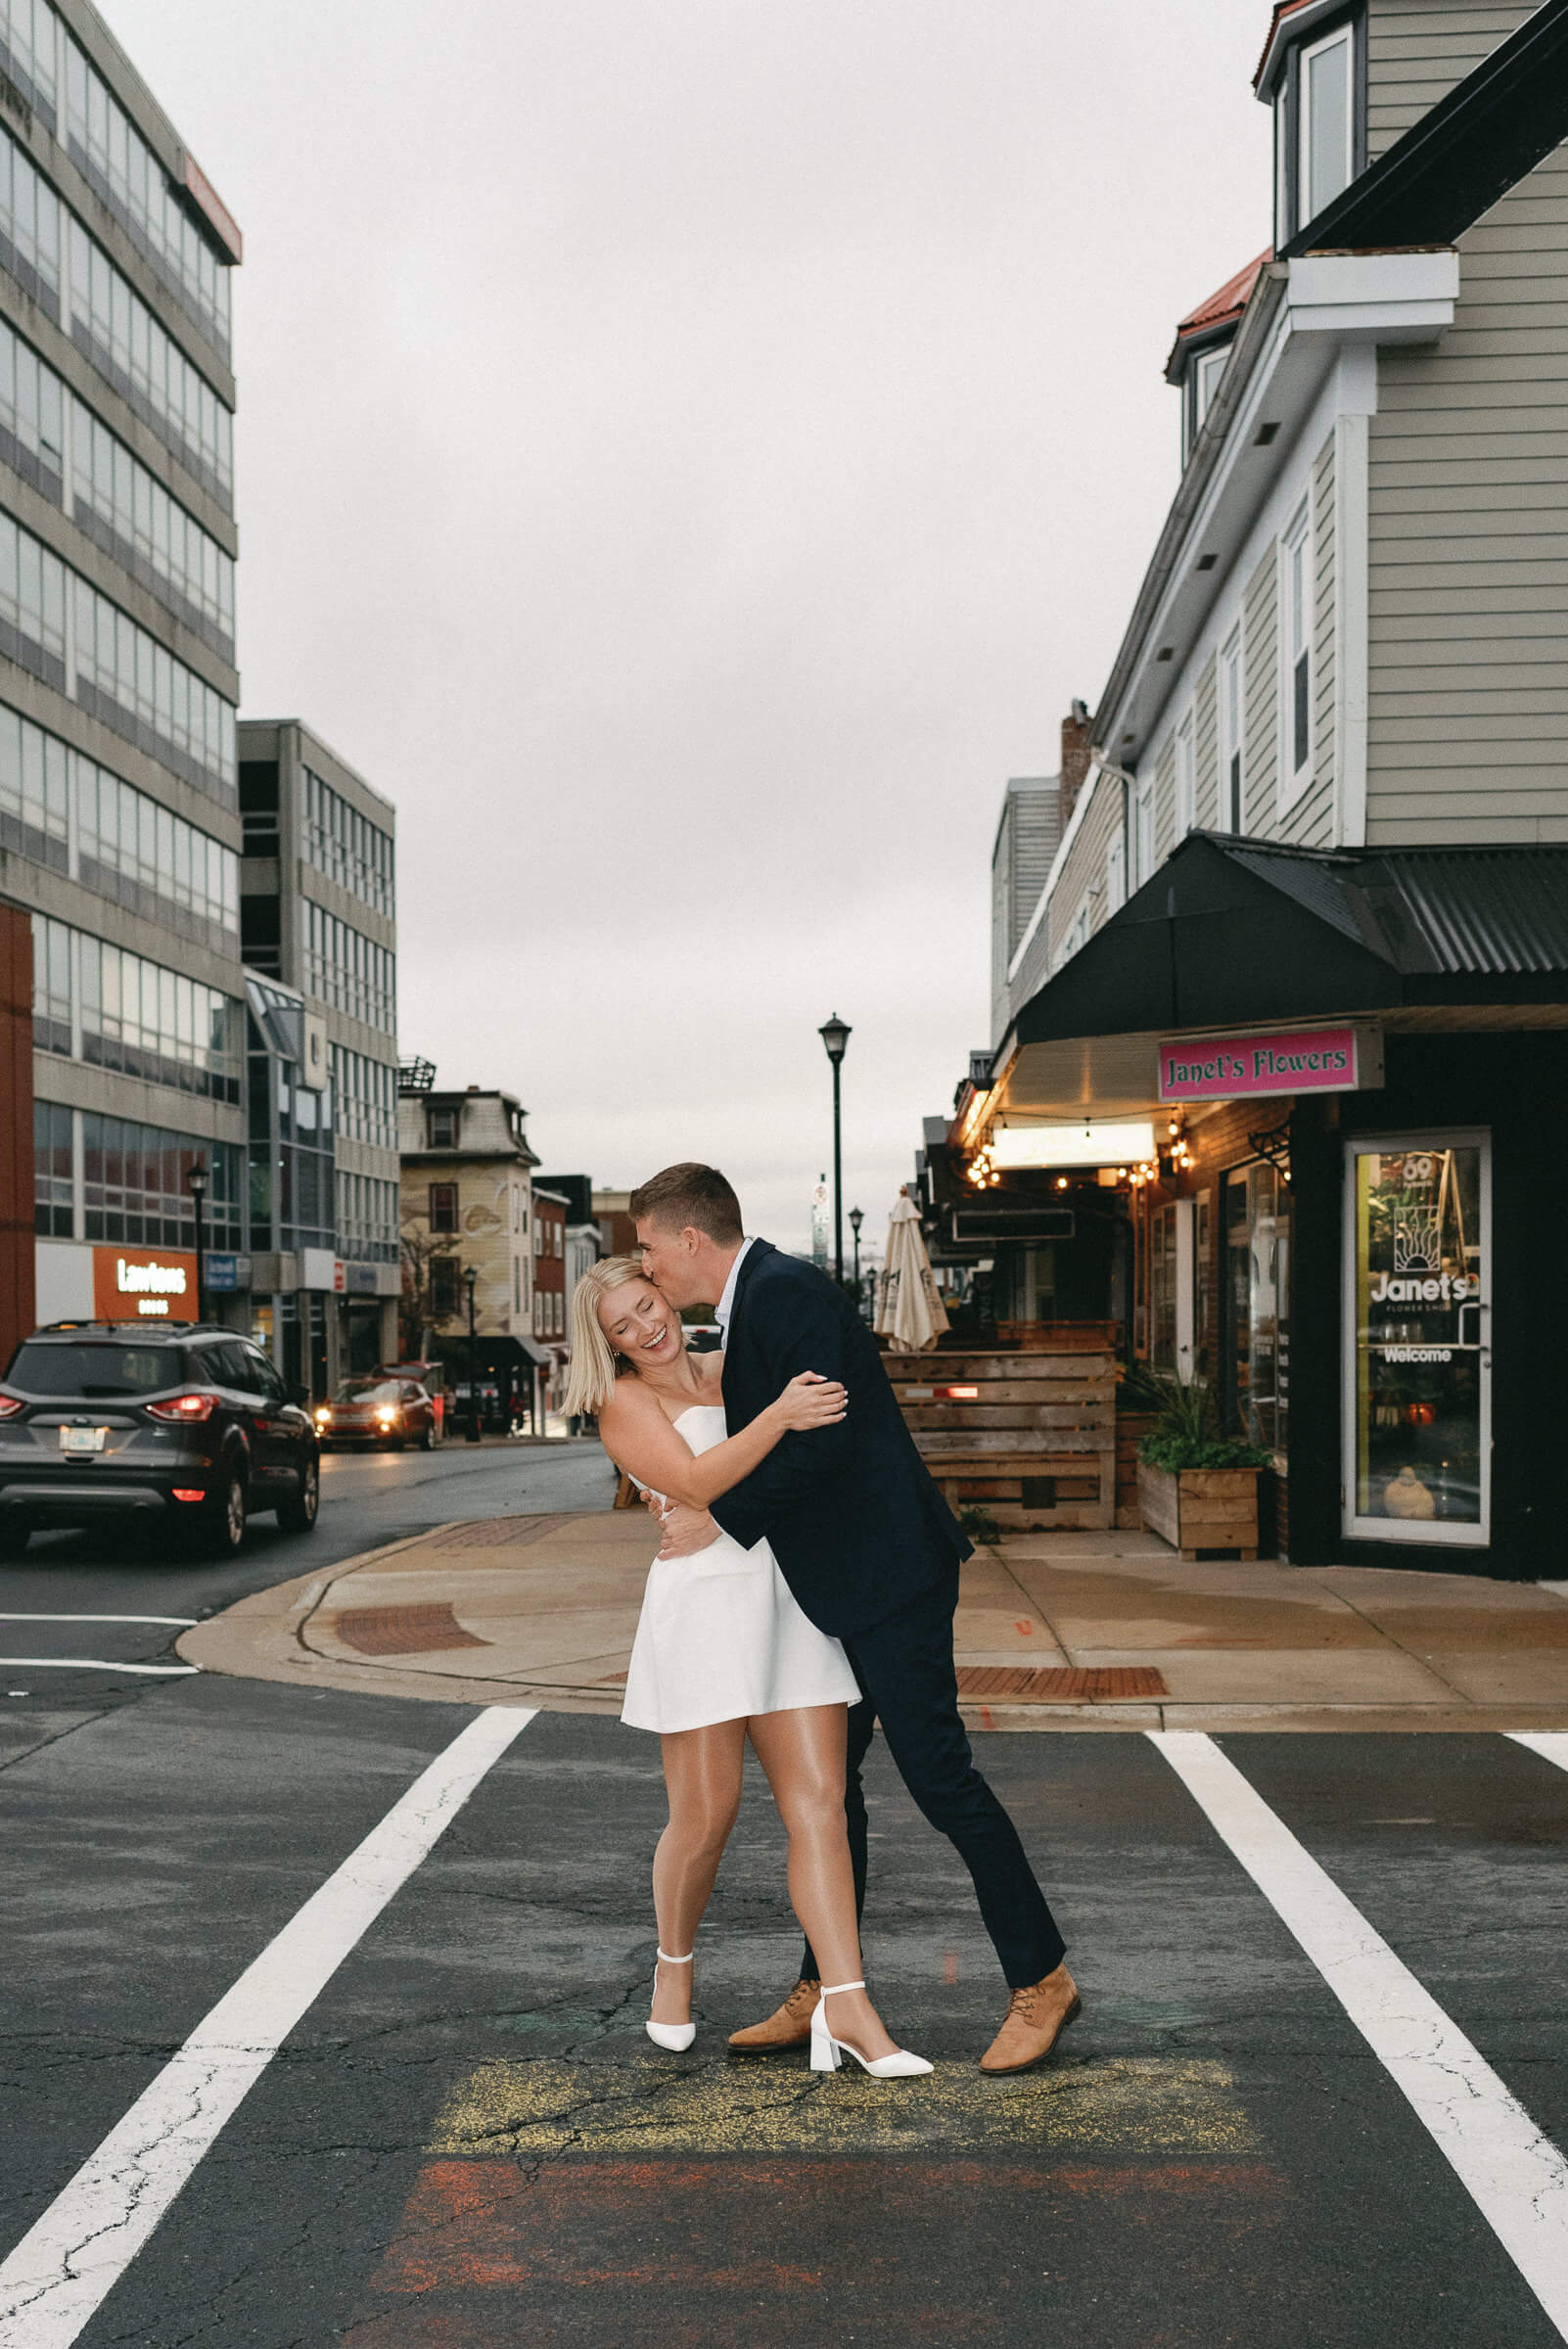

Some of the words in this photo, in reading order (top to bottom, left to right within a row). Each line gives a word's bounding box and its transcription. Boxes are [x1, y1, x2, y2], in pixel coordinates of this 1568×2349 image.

[1167, 1054, 1244, 1088] Janet's
[1253, 1049, 1347, 1081] Flowers
[1403, 1157, 1432, 1181] 69
[1370, 1272, 1468, 1302] Janet's
[1384, 1347, 1453, 1363] Welcome
